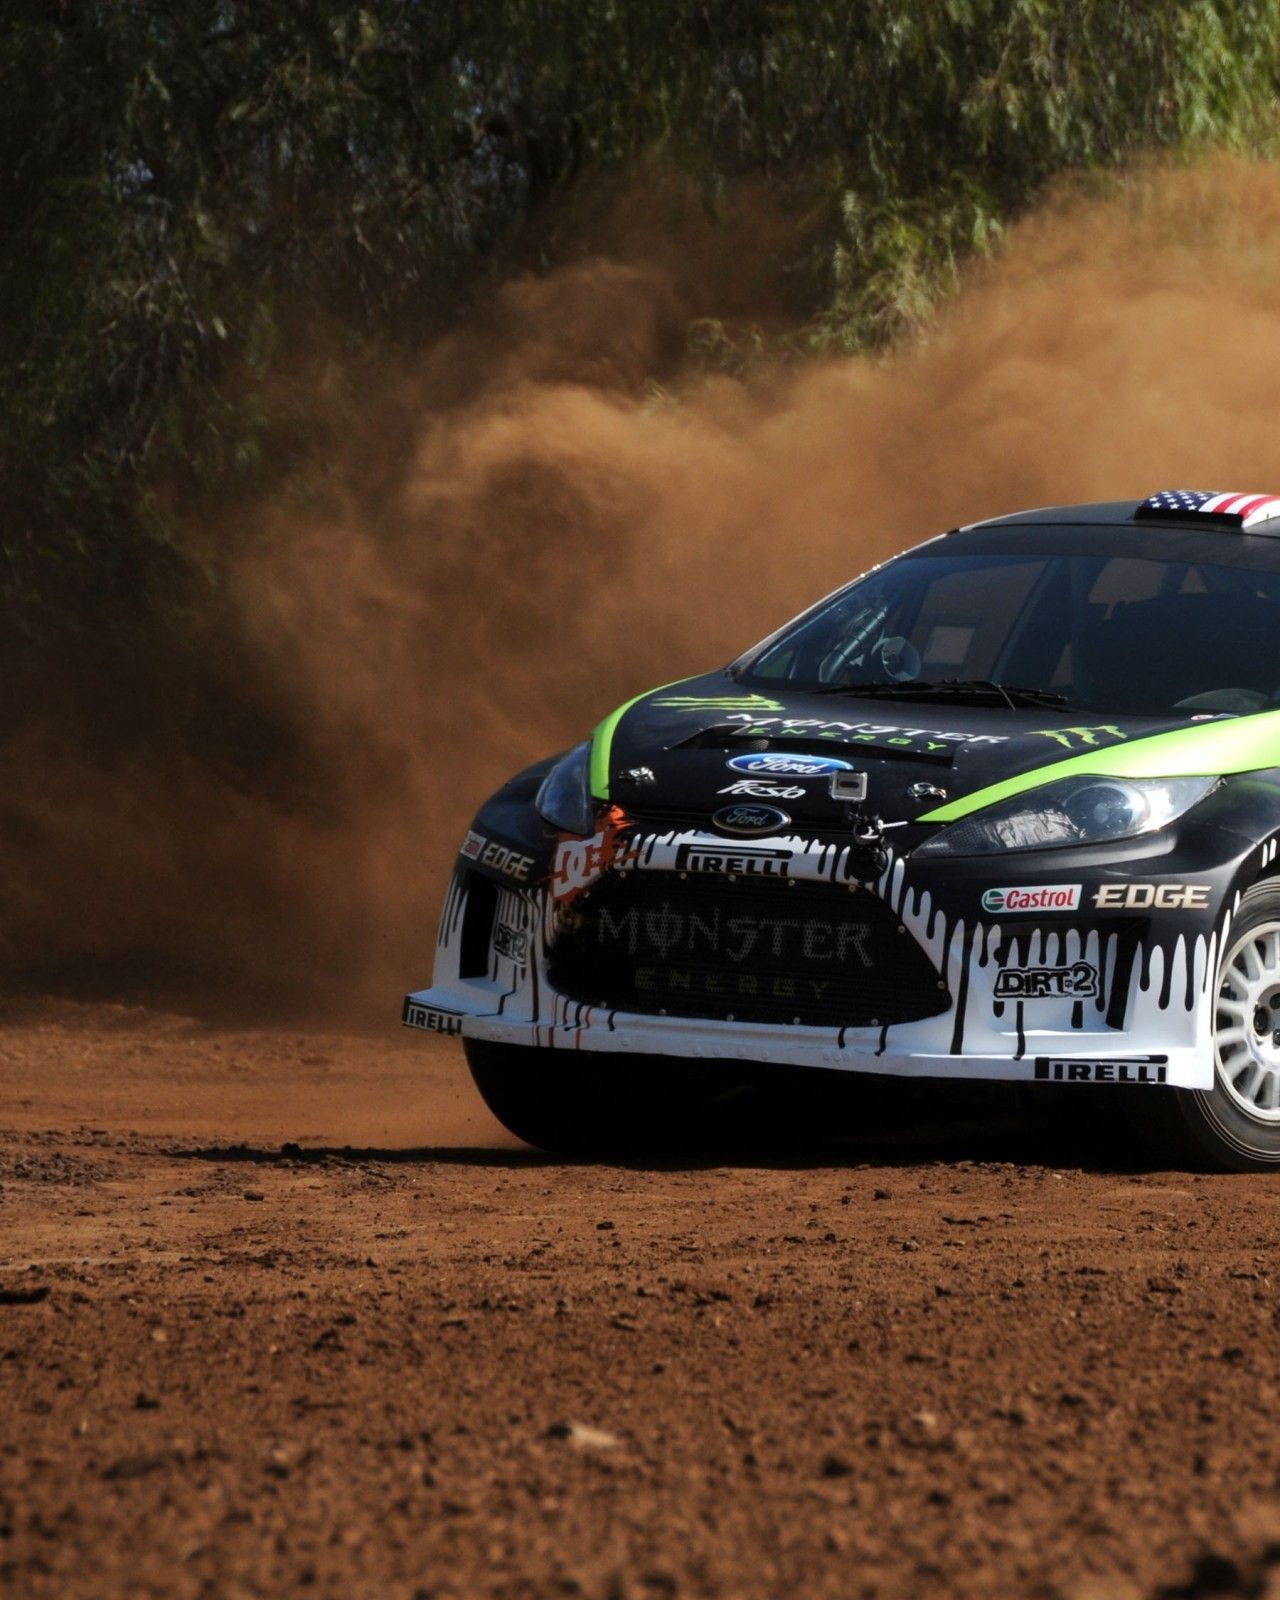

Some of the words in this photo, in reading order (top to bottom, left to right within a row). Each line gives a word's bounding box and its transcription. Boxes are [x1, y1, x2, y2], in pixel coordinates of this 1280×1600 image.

[748, 756, 829, 774] Ford
[726, 808, 770, 826] Ford
[481, 842, 535, 880] EDGE
[675, 843, 794, 877] PIRELLI
[1006, 888, 1074, 909] Castrol
[1092, 884, 1212, 909] EDGE
[1034, 1055, 1169, 1082] PIRELLI
